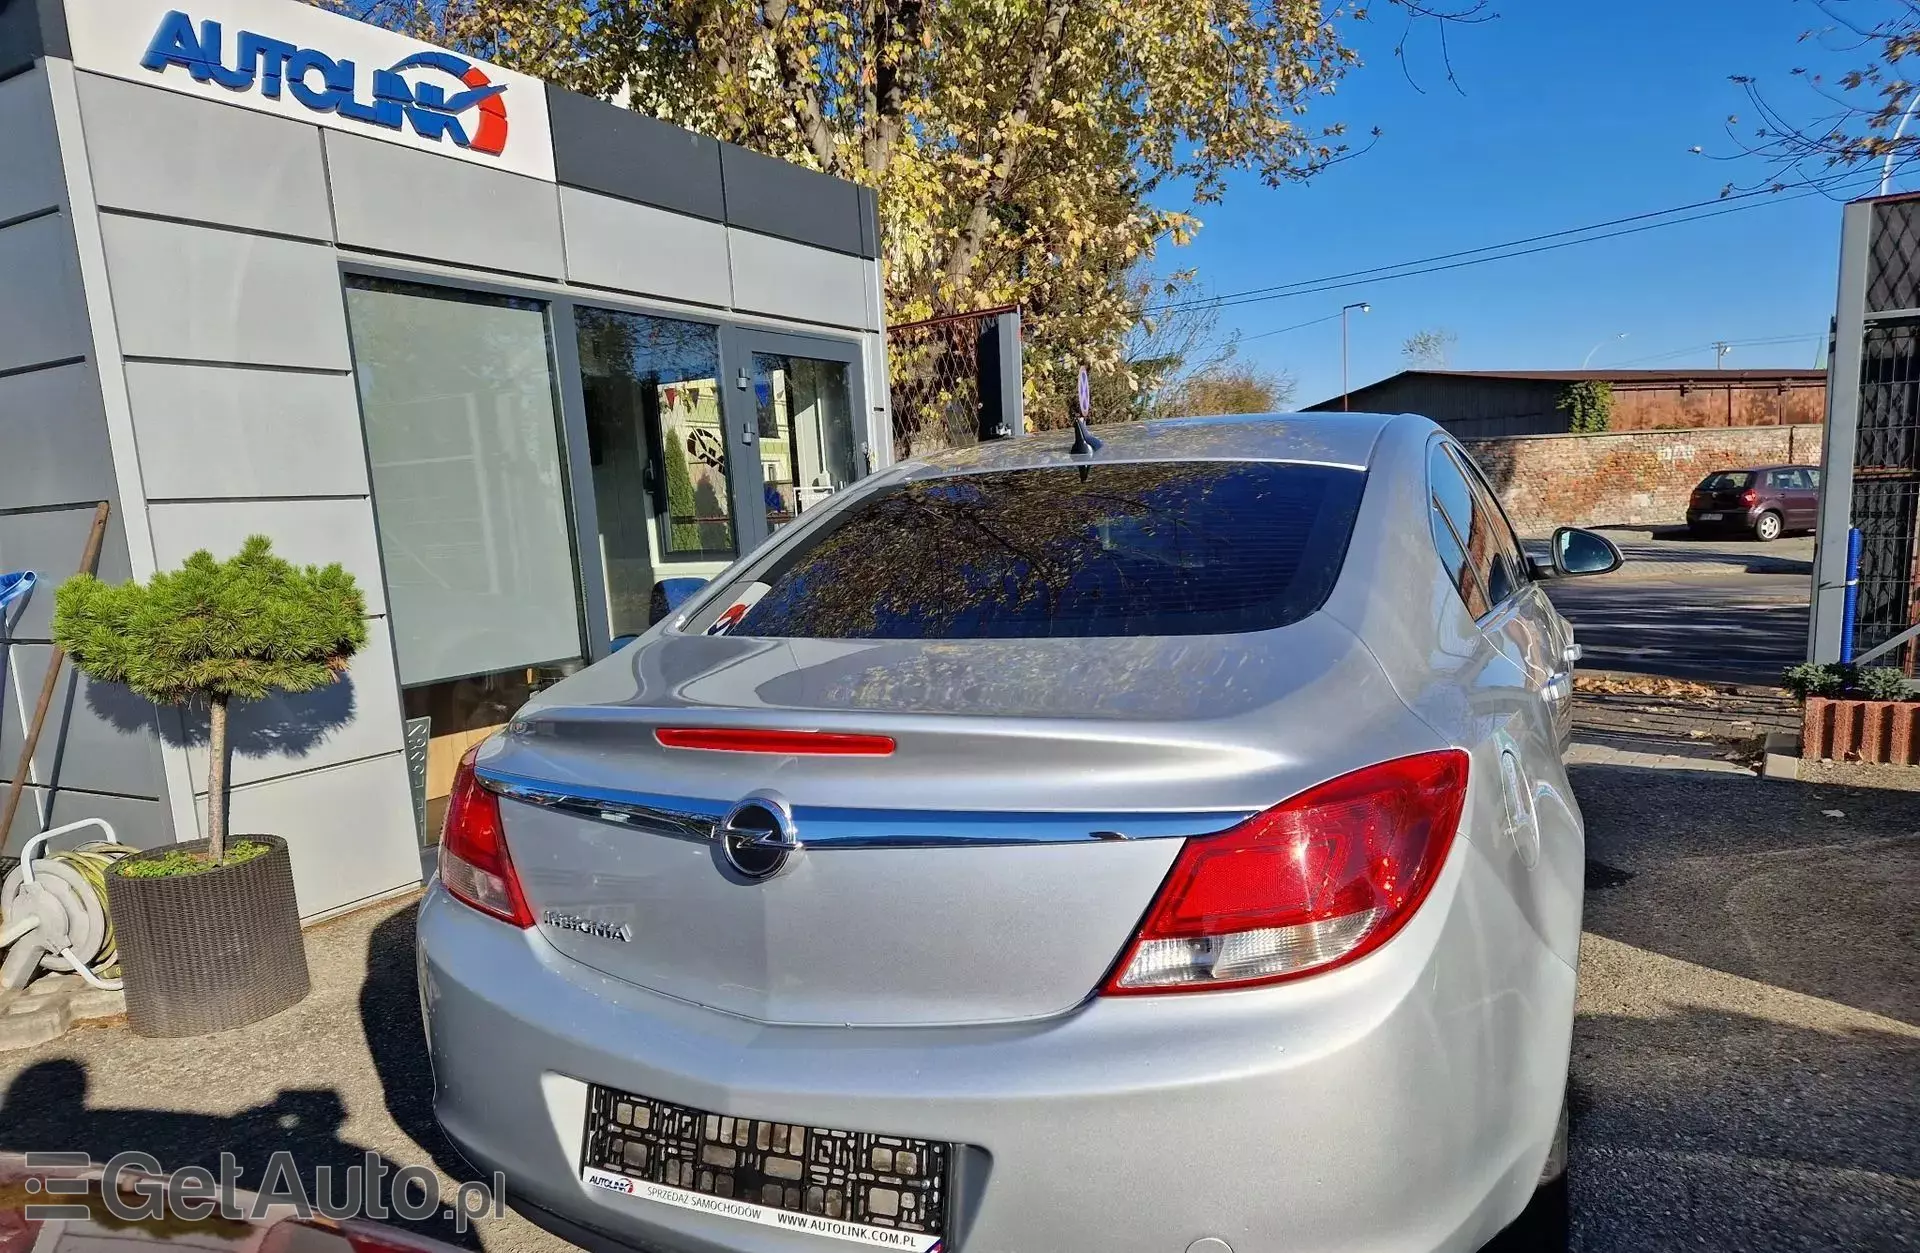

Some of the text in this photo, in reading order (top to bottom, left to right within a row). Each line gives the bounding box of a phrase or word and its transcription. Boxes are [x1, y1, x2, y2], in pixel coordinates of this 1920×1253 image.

[140, 9, 508, 150] AUTOLINK
[589, 1174, 633, 1194] AUTOLINK
[691, 1196, 762, 1220] SAMOCHODÓW
[777, 1212, 917, 1248] WWW.AUTOLINK.COM.PL
